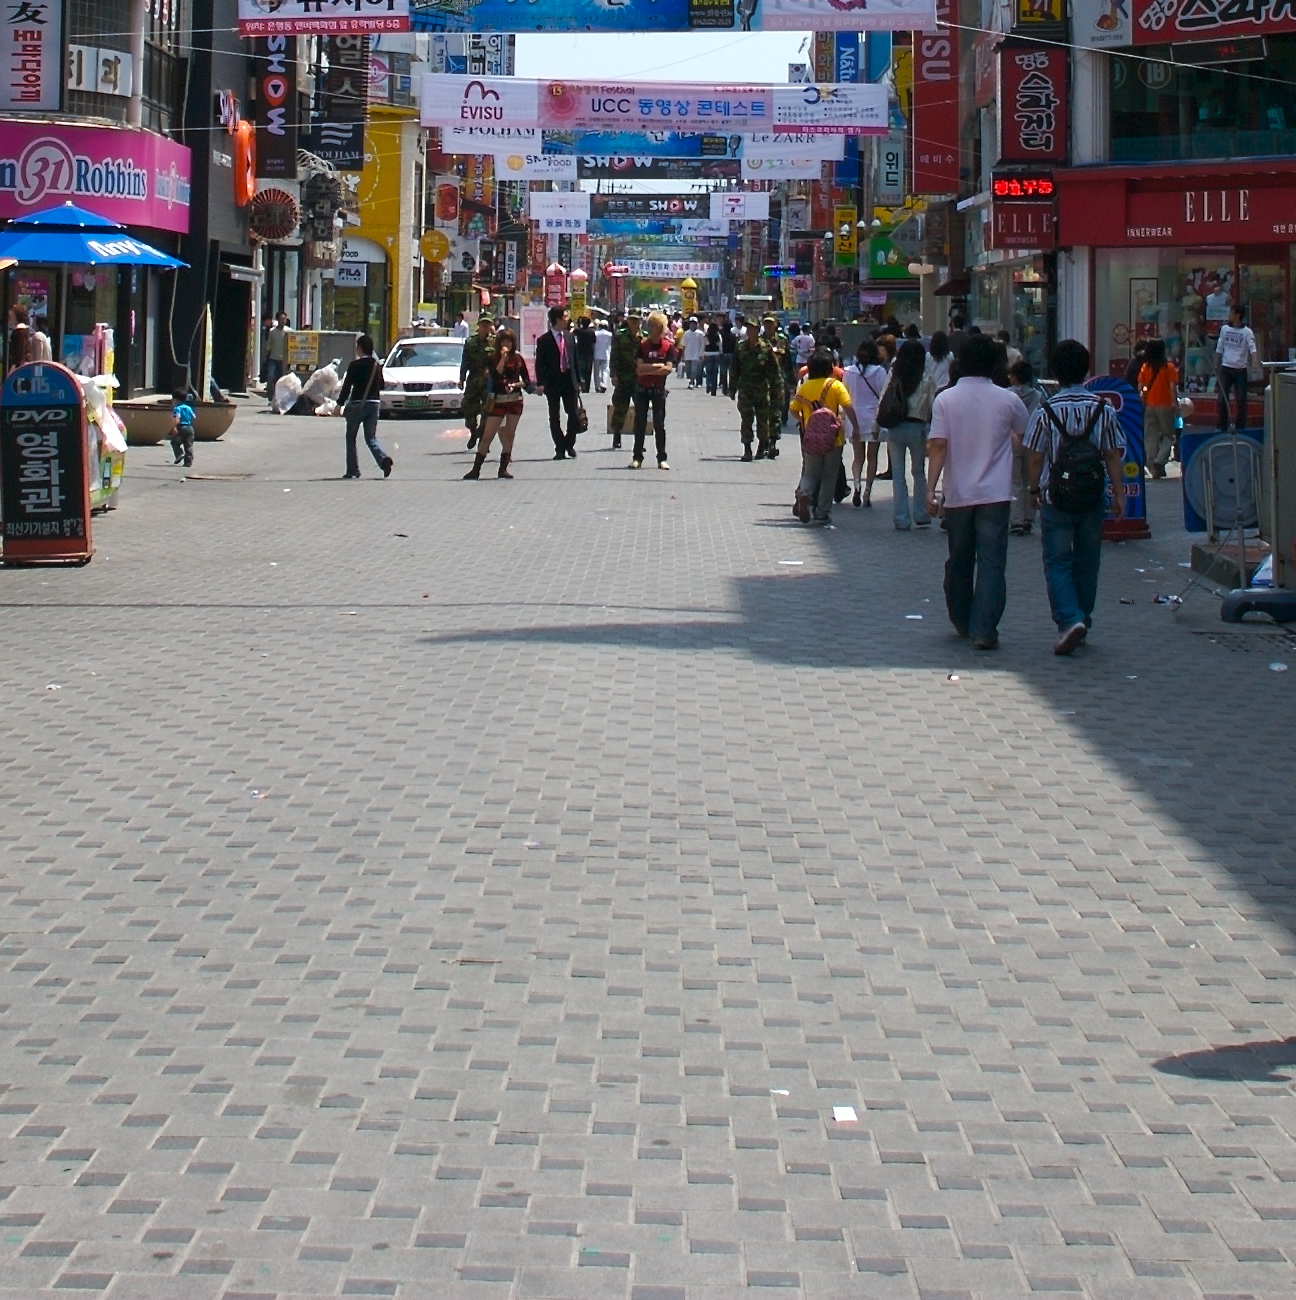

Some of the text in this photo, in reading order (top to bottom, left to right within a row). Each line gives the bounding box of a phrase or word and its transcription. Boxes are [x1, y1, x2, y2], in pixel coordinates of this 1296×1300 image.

[10, 29, 43, 104] 로바다야끼
[1014, 51, 1050, 71] 명동
[460, 105, 504, 121] EVISU
[590, 98, 632, 114] UCC
[637, 98, 692, 117] 동영상
[696, 99, 767, 117] 콘테스트
[313, 150, 360, 161] POLHAM
[74, 158, 148, 198] Robbins
[1184, 189, 1250, 223] ELLE
[997, 212, 1051, 234] ELLE
[1126, 226, 1173, 238] INNERWEAR
[338, 266, 362, 276] FILA
[10, 409, 69, 422] DVD
[16, 431, 66, 514] 영화관
[5, 521, 60, 536] 최신기기설치
